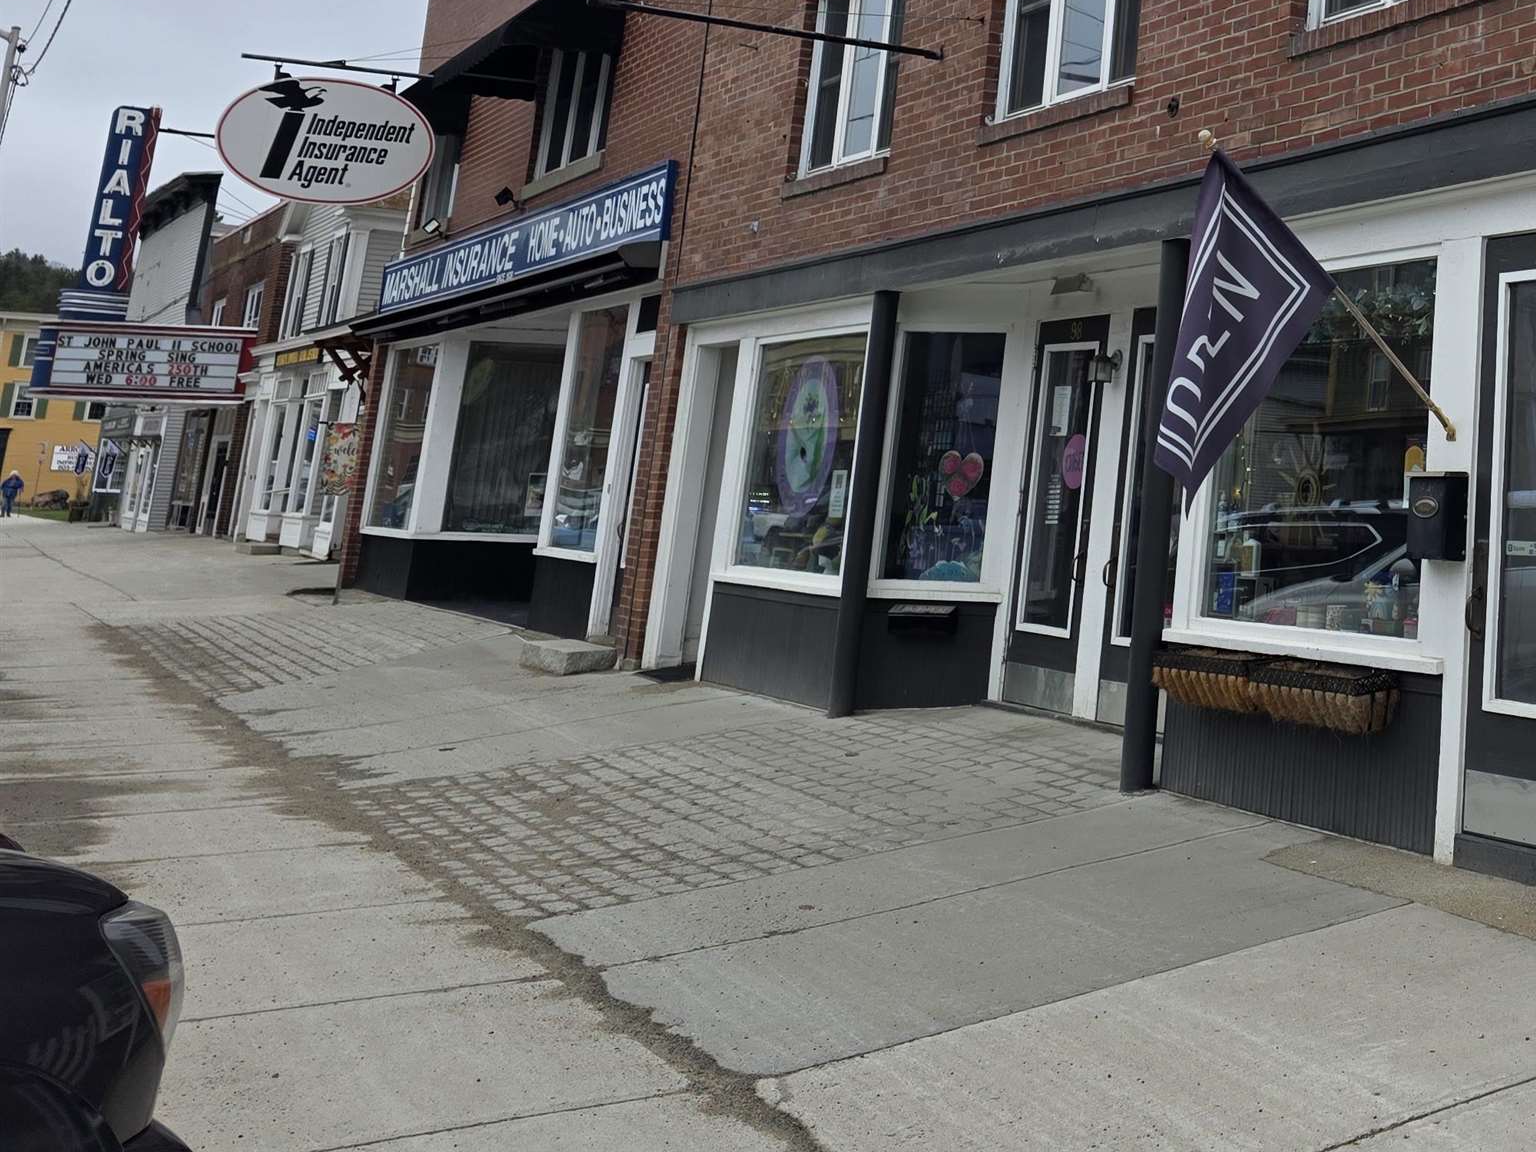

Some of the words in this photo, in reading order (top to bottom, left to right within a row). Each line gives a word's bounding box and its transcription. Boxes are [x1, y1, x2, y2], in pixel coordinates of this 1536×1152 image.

[306, 113, 415, 144] Independent
[297, 136, 388, 165] Insurance
[287, 160, 349, 189] Agent
[86, 108, 145, 287] RIALTO
[381, 256, 440, 305] MARSHALL
[440, 230, 520, 290] INSURANCE
[58, 335, 73, 346] ST
[84, 337, 117, 348] JOHN
[127, 339, 160, 349] PAUL
[191, 341, 240, 353] SCHOOL
[98, 350, 146, 361] SPRING
[167, 352, 196, 363] SING
[86, 374, 113, 385] WED
[125, 375, 157, 386] 6:00
[169, 377, 200, 388] FREE
[167, 364, 208, 376] 250TH
